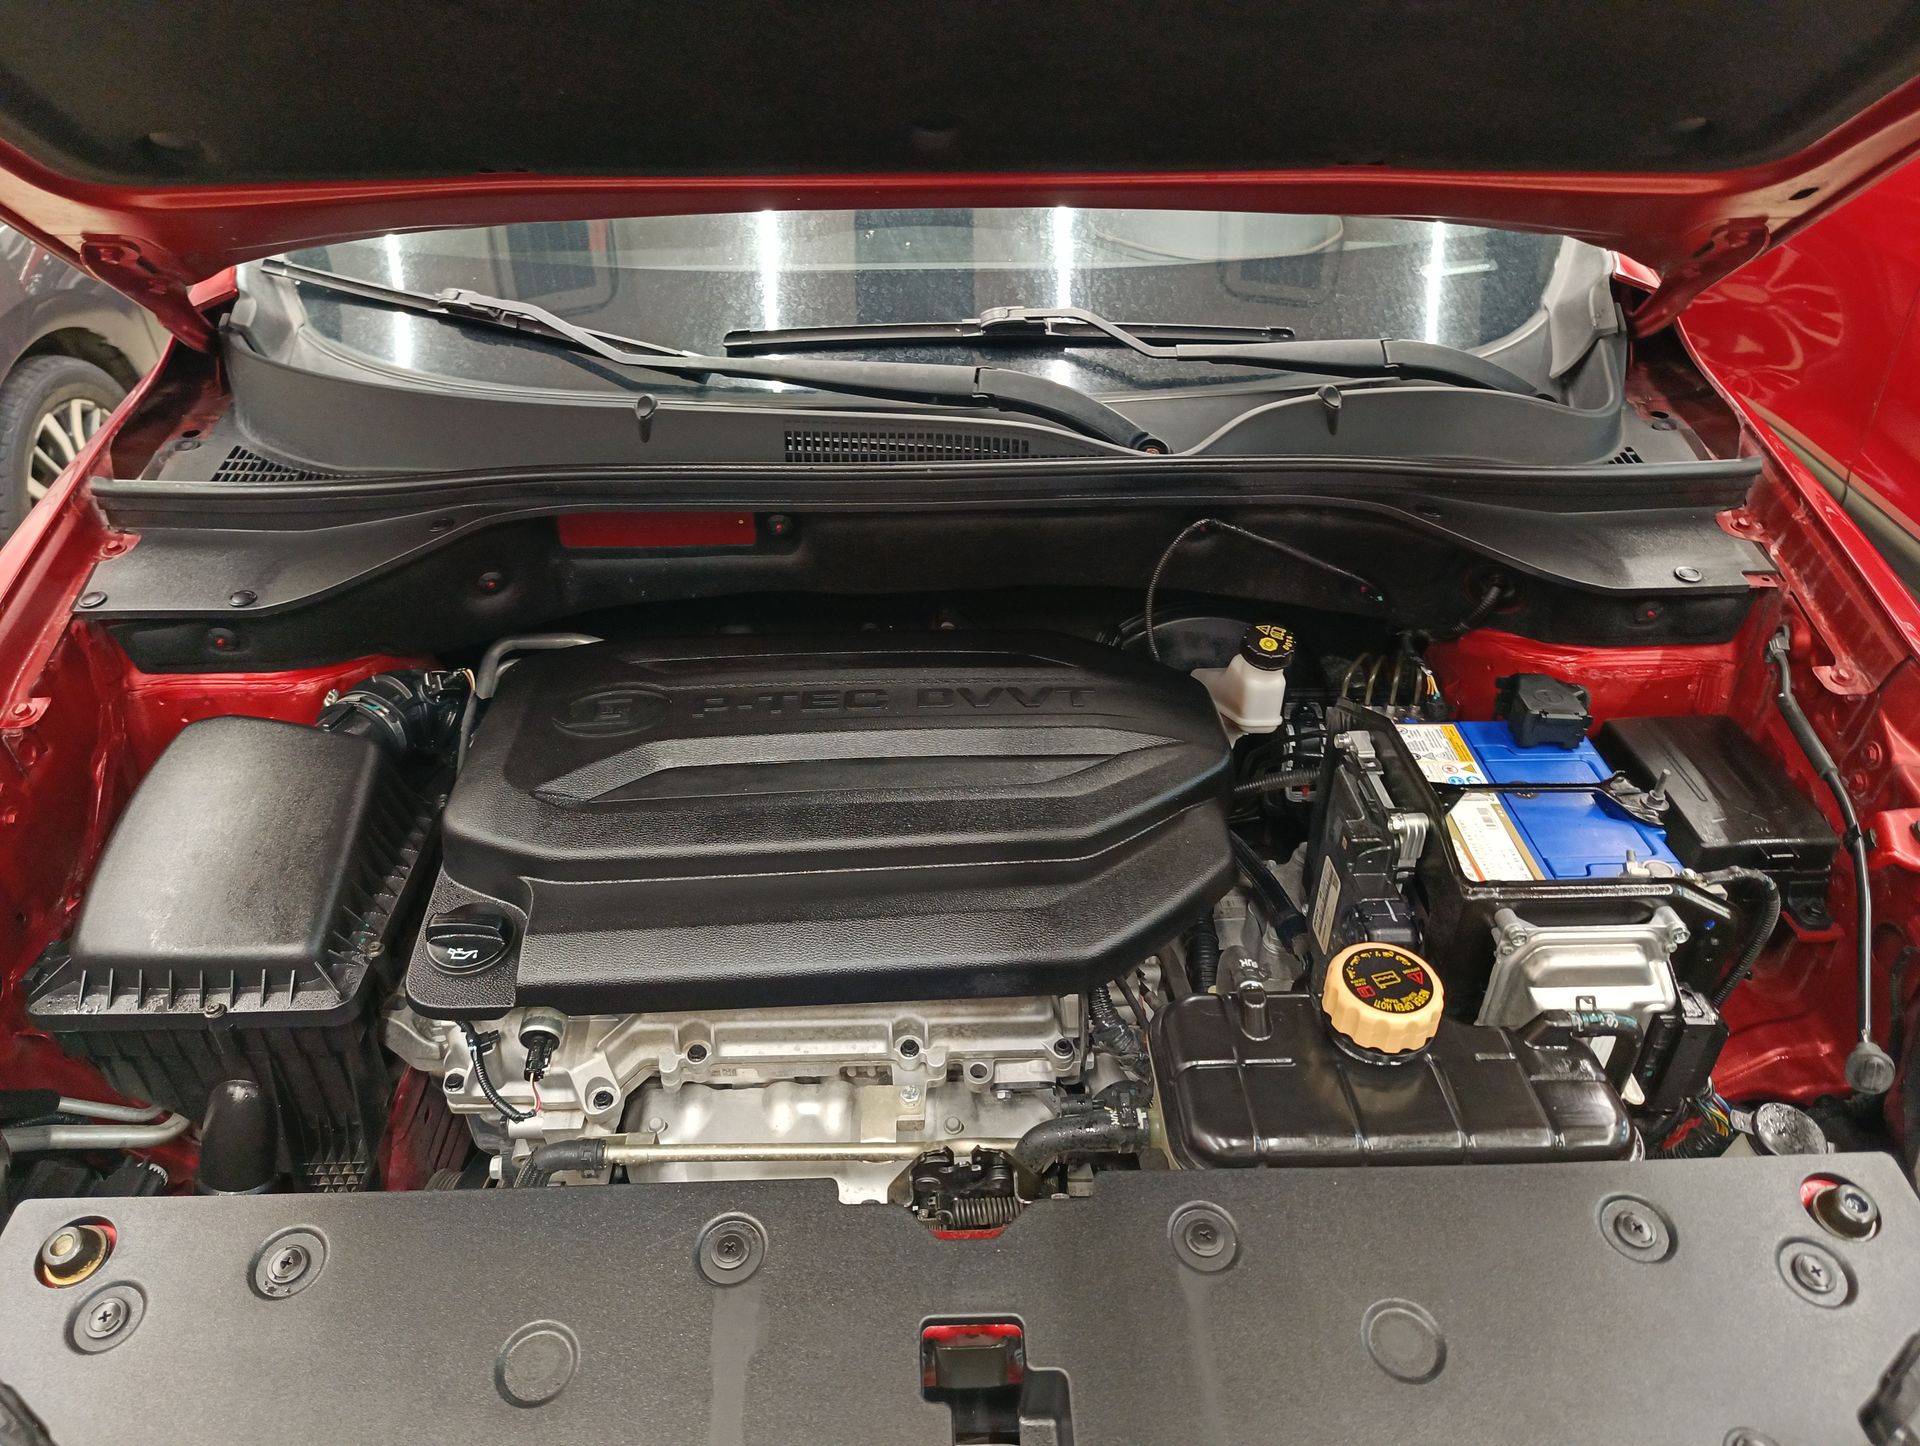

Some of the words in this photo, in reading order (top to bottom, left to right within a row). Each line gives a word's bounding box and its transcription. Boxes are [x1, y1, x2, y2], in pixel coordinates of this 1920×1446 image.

[690, 688, 889, 718] P-TEC
[915, 686, 1097, 708] DVVT
[1394, 1000, 1414, 1011] OPEN
